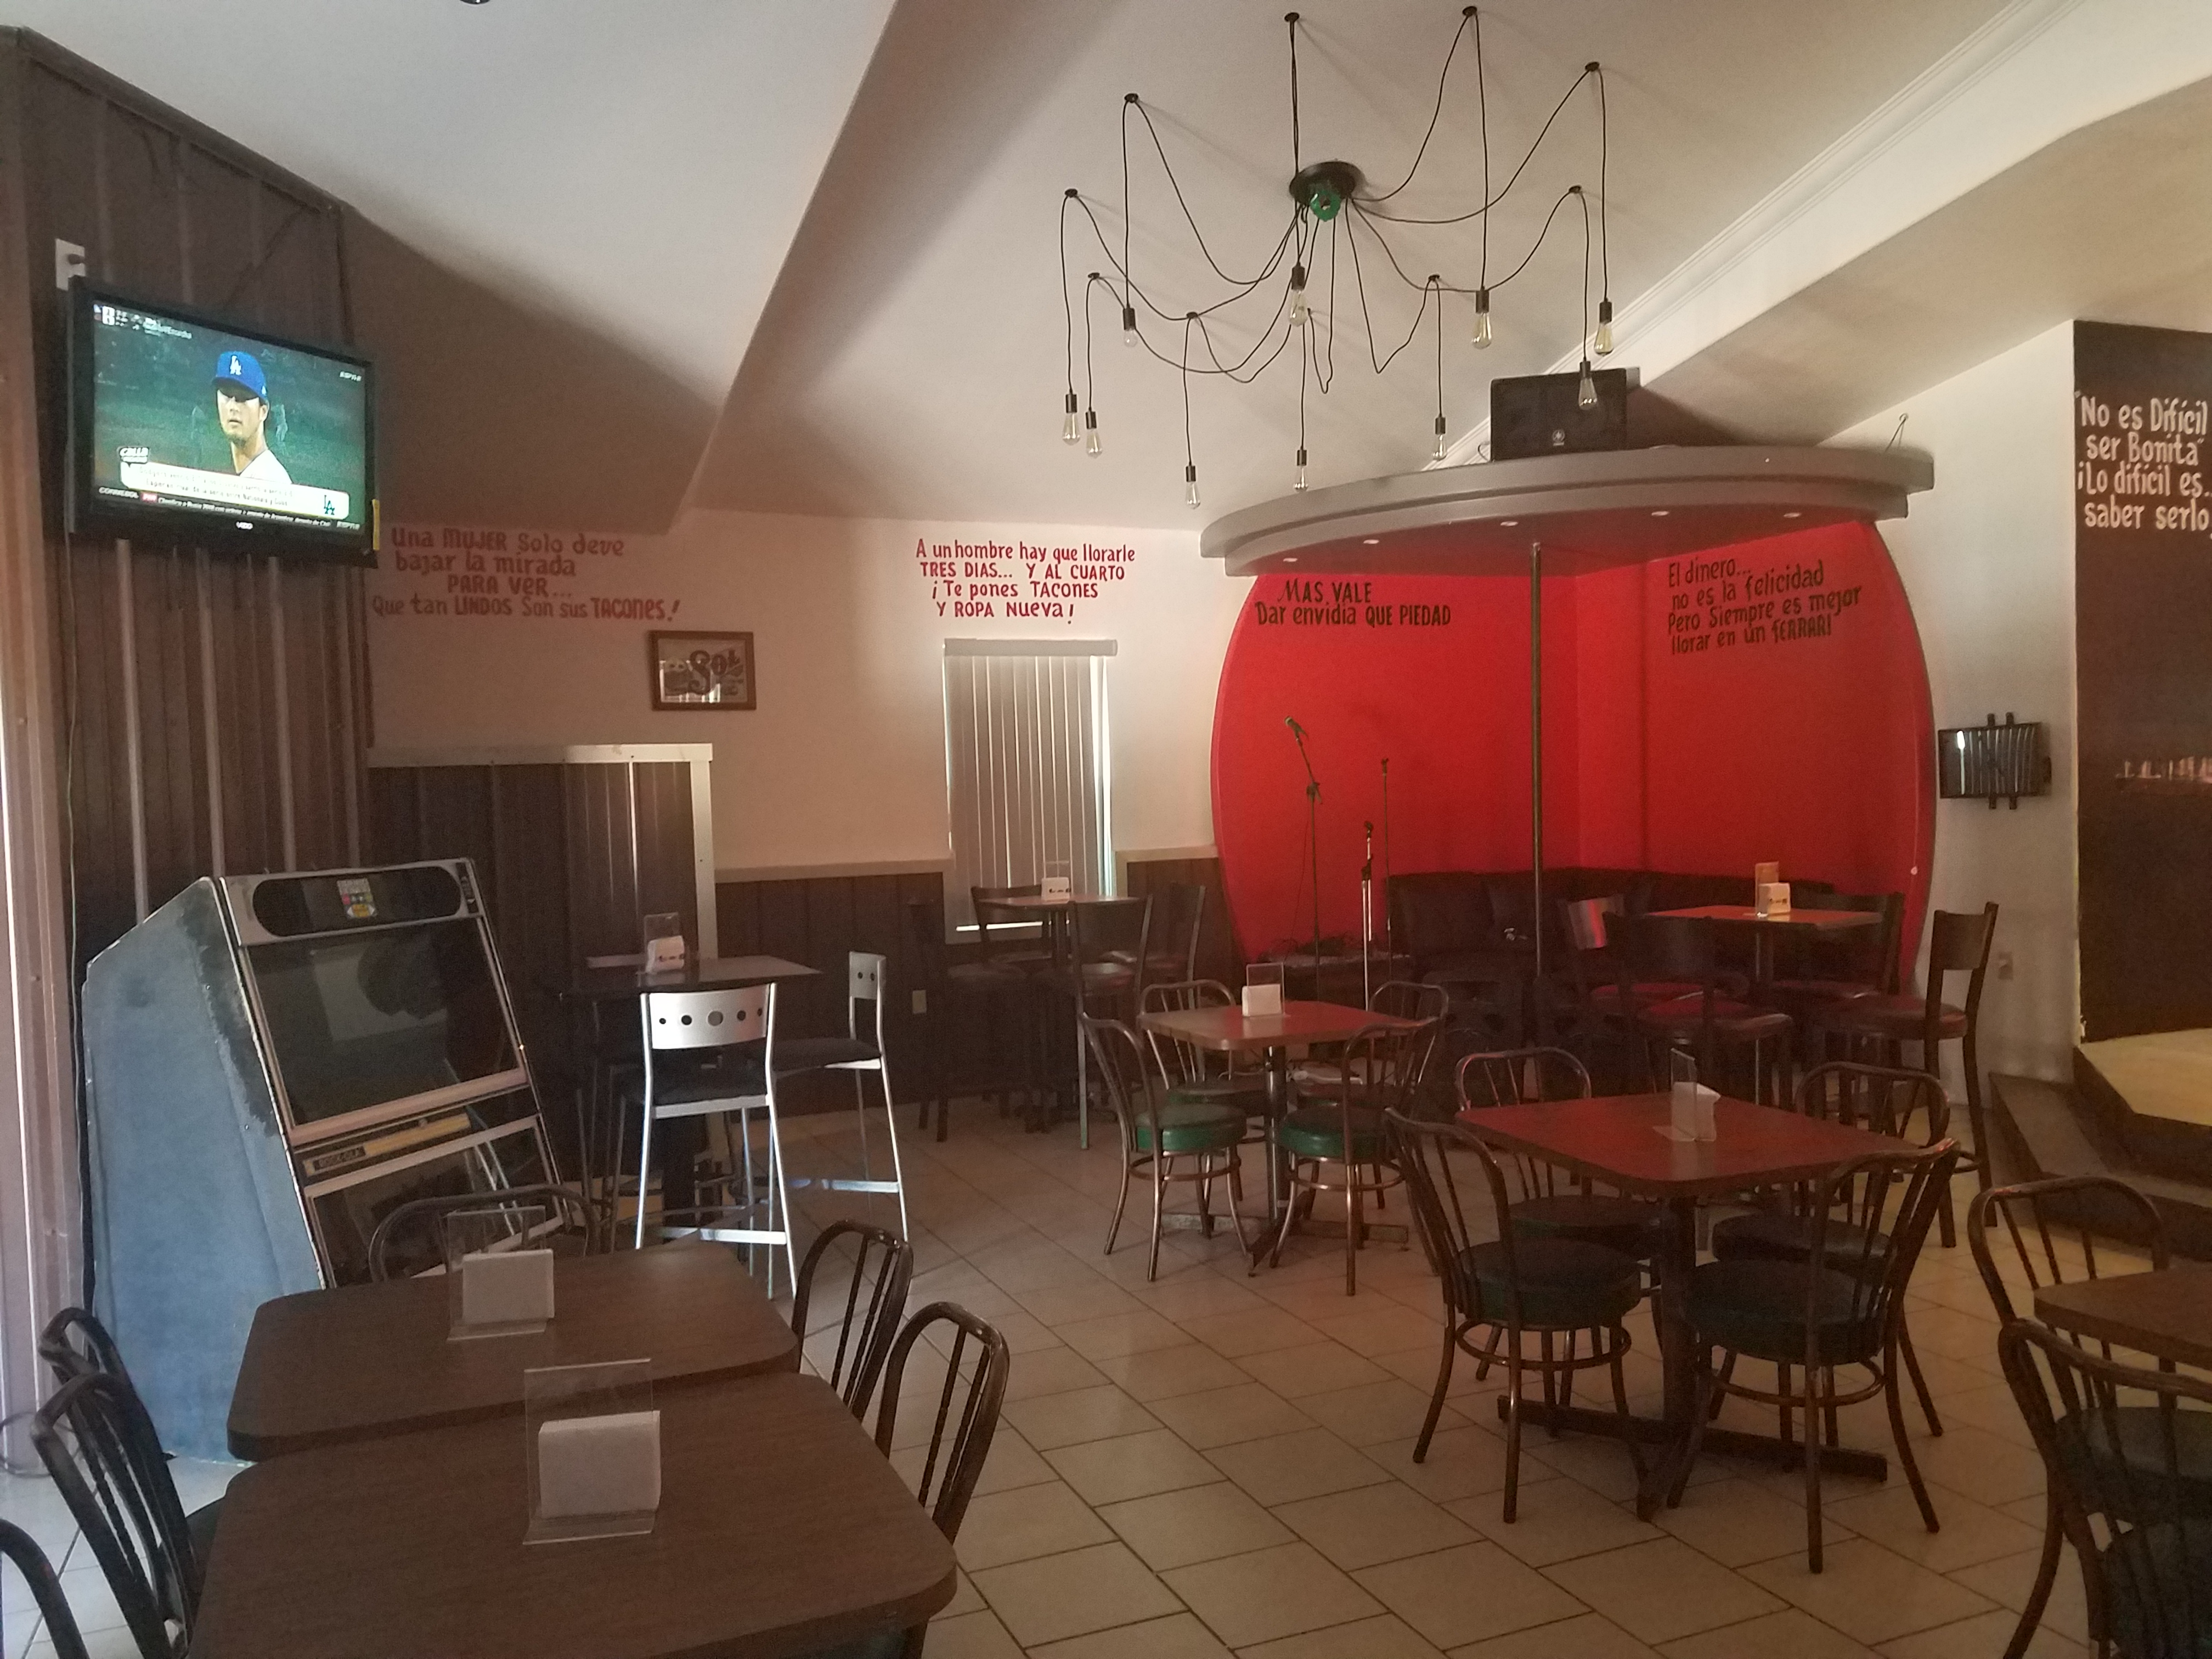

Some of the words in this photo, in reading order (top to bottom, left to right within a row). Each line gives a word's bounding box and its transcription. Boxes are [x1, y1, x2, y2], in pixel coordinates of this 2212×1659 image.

[2118, 405, 2143, 430] es
[2086, 435, 2121, 461] ser
[2085, 494, 2145, 529] saber
[2156, 498, 2209, 531] serlo
[391, 527, 434, 548] Una
[572, 533, 624, 556] deve
[916, 539, 927, 558] A
[1020, 541, 1046, 561] hay
[1053, 546, 1077, 564] que
[1083, 544, 1135, 561] llorarle
[396, 551, 456, 575] bajar
[465, 551, 486, 572] la
[494, 552, 576, 576] mirada
[921, 562, 956, 577] TRES
[1026, 564, 1036, 578] Y
[1045, 565, 1062, 579] AL
[1071, 565, 1125, 582] CUARTO
[1669, 562, 1680, 587] El
[448, 574, 499, 594] PARA
[970, 583, 1018, 600] pones
[1277, 578, 1323, 603] MAS
[1332, 582, 1372, 603] VALE
[1673, 592, 1689, 610] no
[1697, 588, 1714, 605] es
[1723, 580, 1736, 602] la
[1746, 559, 1824, 601] felicidad
[372, 596, 404, 616] Que
[413, 593, 448, 616] tan
[559, 601, 588, 618] sus
[937, 602, 946, 616] Y
[955, 602, 994, 617] ROPA
[1783, 598, 1802, 614] es
[1809, 585, 1862, 616] mejor
[1255, 601, 1286, 625] Dar
[1293, 602, 1356, 625] envidia
[1365, 605, 1392, 627] QUE
[1400, 605, 1451, 626] PIEDAD
[1672, 634, 1711, 654] llorar
[1717, 630, 1735, 647] en
[1744, 625, 1765, 644] un
